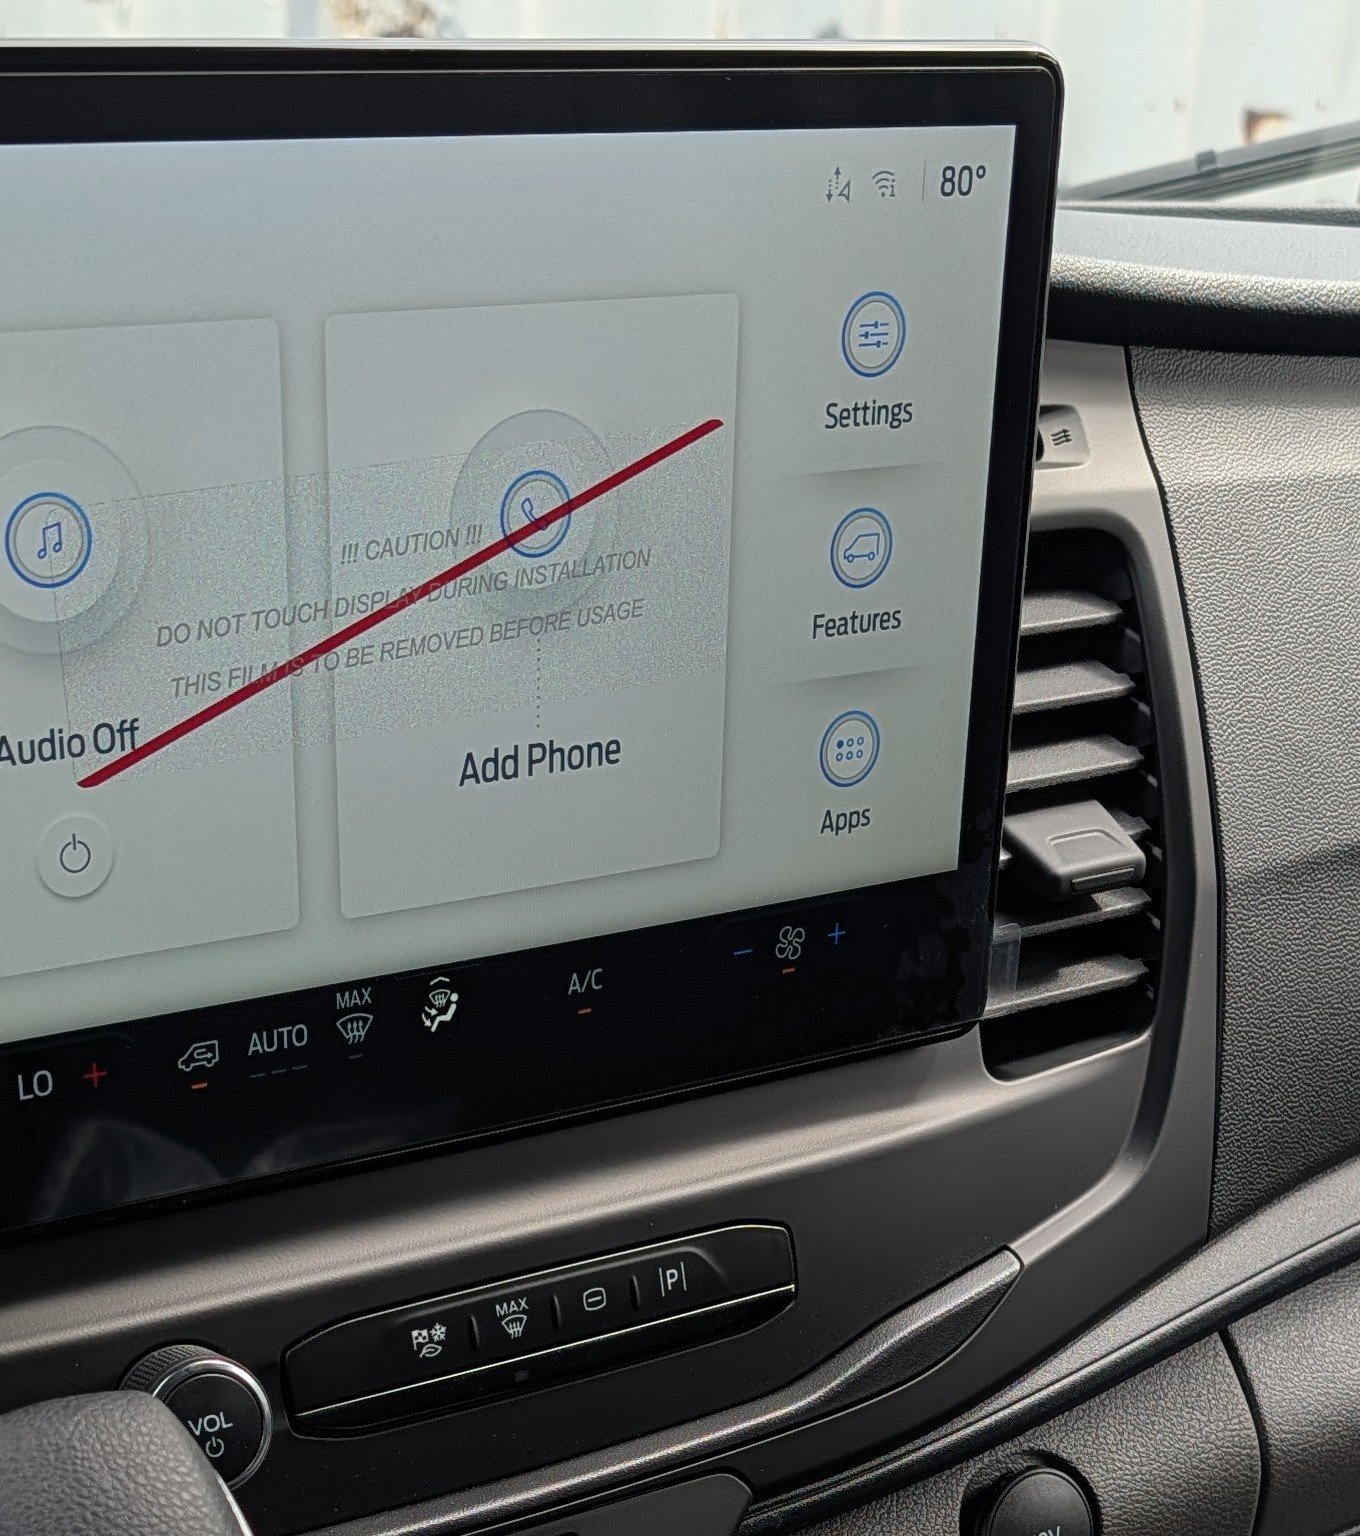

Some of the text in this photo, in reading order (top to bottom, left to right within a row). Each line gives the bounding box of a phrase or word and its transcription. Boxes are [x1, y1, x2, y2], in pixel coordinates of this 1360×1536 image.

[939, 164, 988, 197] 80°
[824, 399, 914, 432] Settings
[365, 527, 460, 561] CAUTION
[157, 548, 652, 647] DO NOT TOUCH DISPLAY DURING INSTALLATION
[812, 609, 902, 640] Features
[171, 671, 222, 698] THIS
[345, 643, 375, 668] BE
[380, 625, 484, 662] REMOVED
[490, 610, 572, 643] BEFORE
[577, 599, 645, 628] USAGE
[93, 718, 139, 754] Off
[459, 739, 621, 787] Add Phone
[820, 806, 871, 836] Apps
[568, 967, 604, 996] A/C
[336, 987, 372, 1010] MAX
[248, 1024, 309, 1056] AUTO
[17, 1069, 54, 1102] LO
[495, 1297, 529, 1318] MAX
[188, 1411, 233, 1437] VOL
